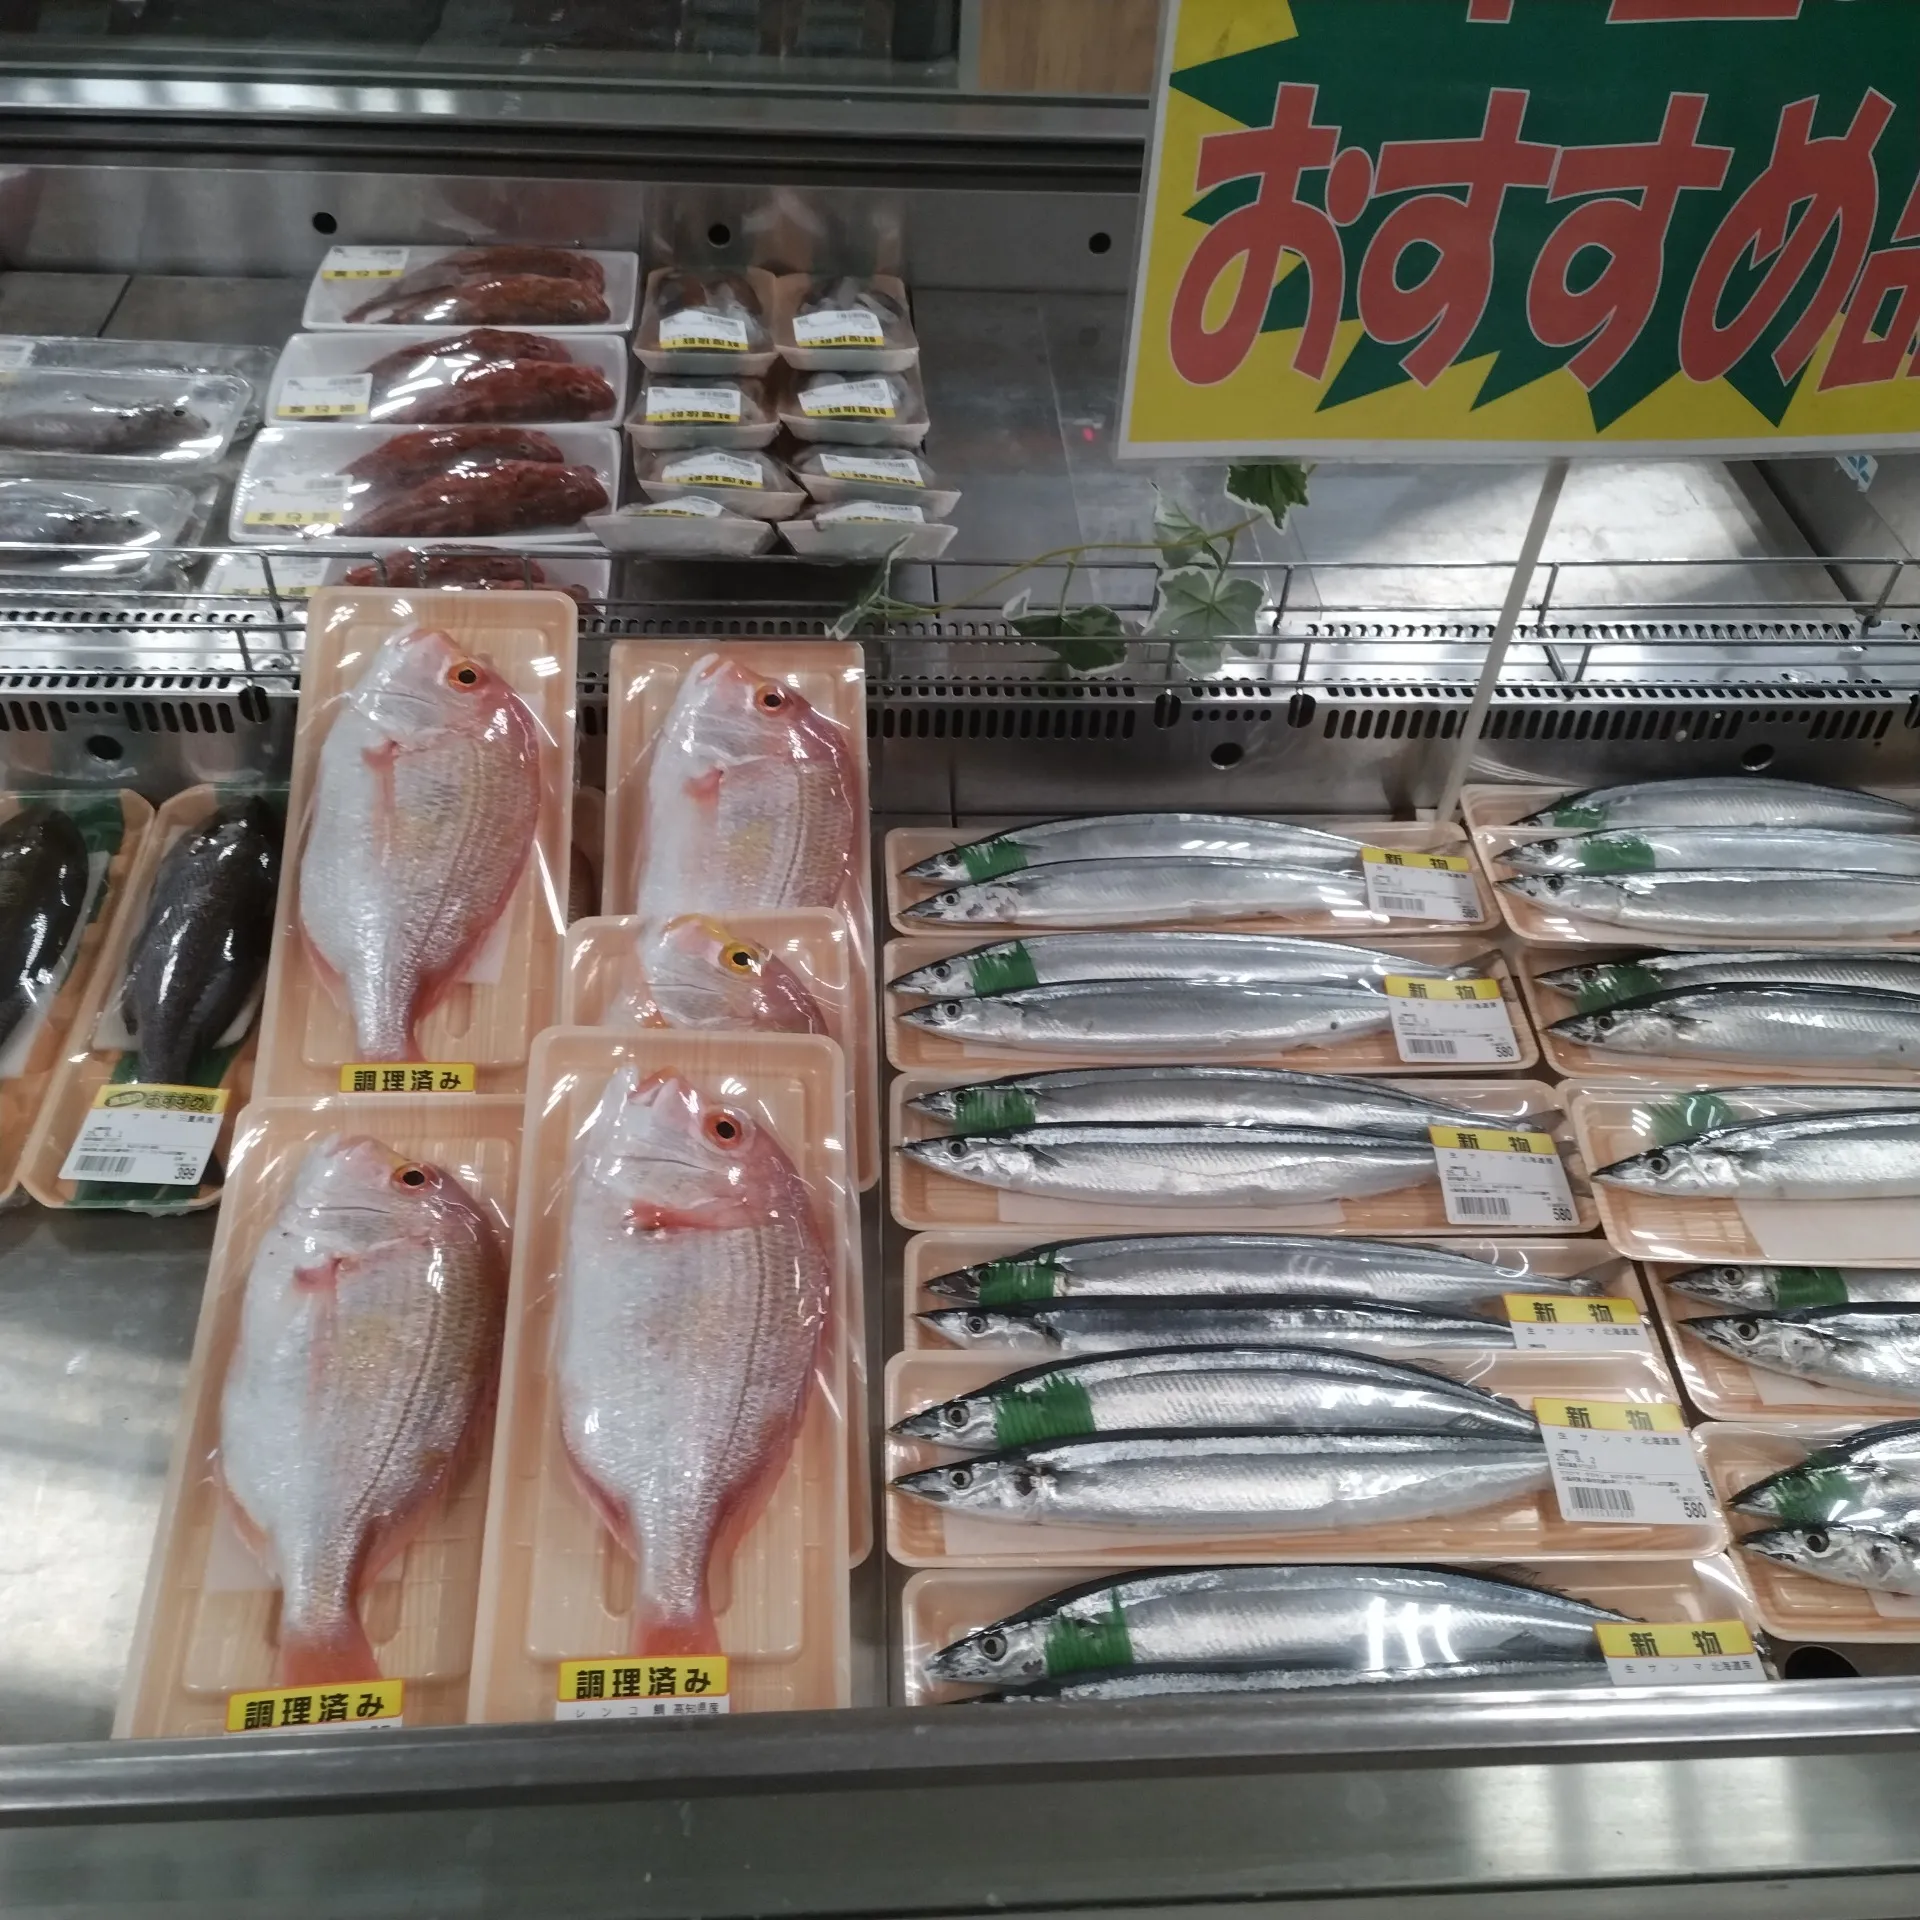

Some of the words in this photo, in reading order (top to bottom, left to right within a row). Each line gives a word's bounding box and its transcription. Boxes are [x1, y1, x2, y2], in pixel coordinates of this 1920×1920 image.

[1495, 1046, 1514, 1057] 580
[354, 1069, 461, 1092] 調理済み
[174, 1167, 197, 1180] 399
[1552, 1207, 1573, 1221] 580
[1533, 1301, 1614, 1322] 新物
[1564, 1406, 1654, 1431] 新物
[1682, 1501, 1707, 1518] 580
[1628, 1630, 1723, 1656] 新物
[576, 1666, 711, 1699] 調理済み
[244, 1692, 384, 1730] 調理済み
[673, 1702, 720, 1716] 高知県産
